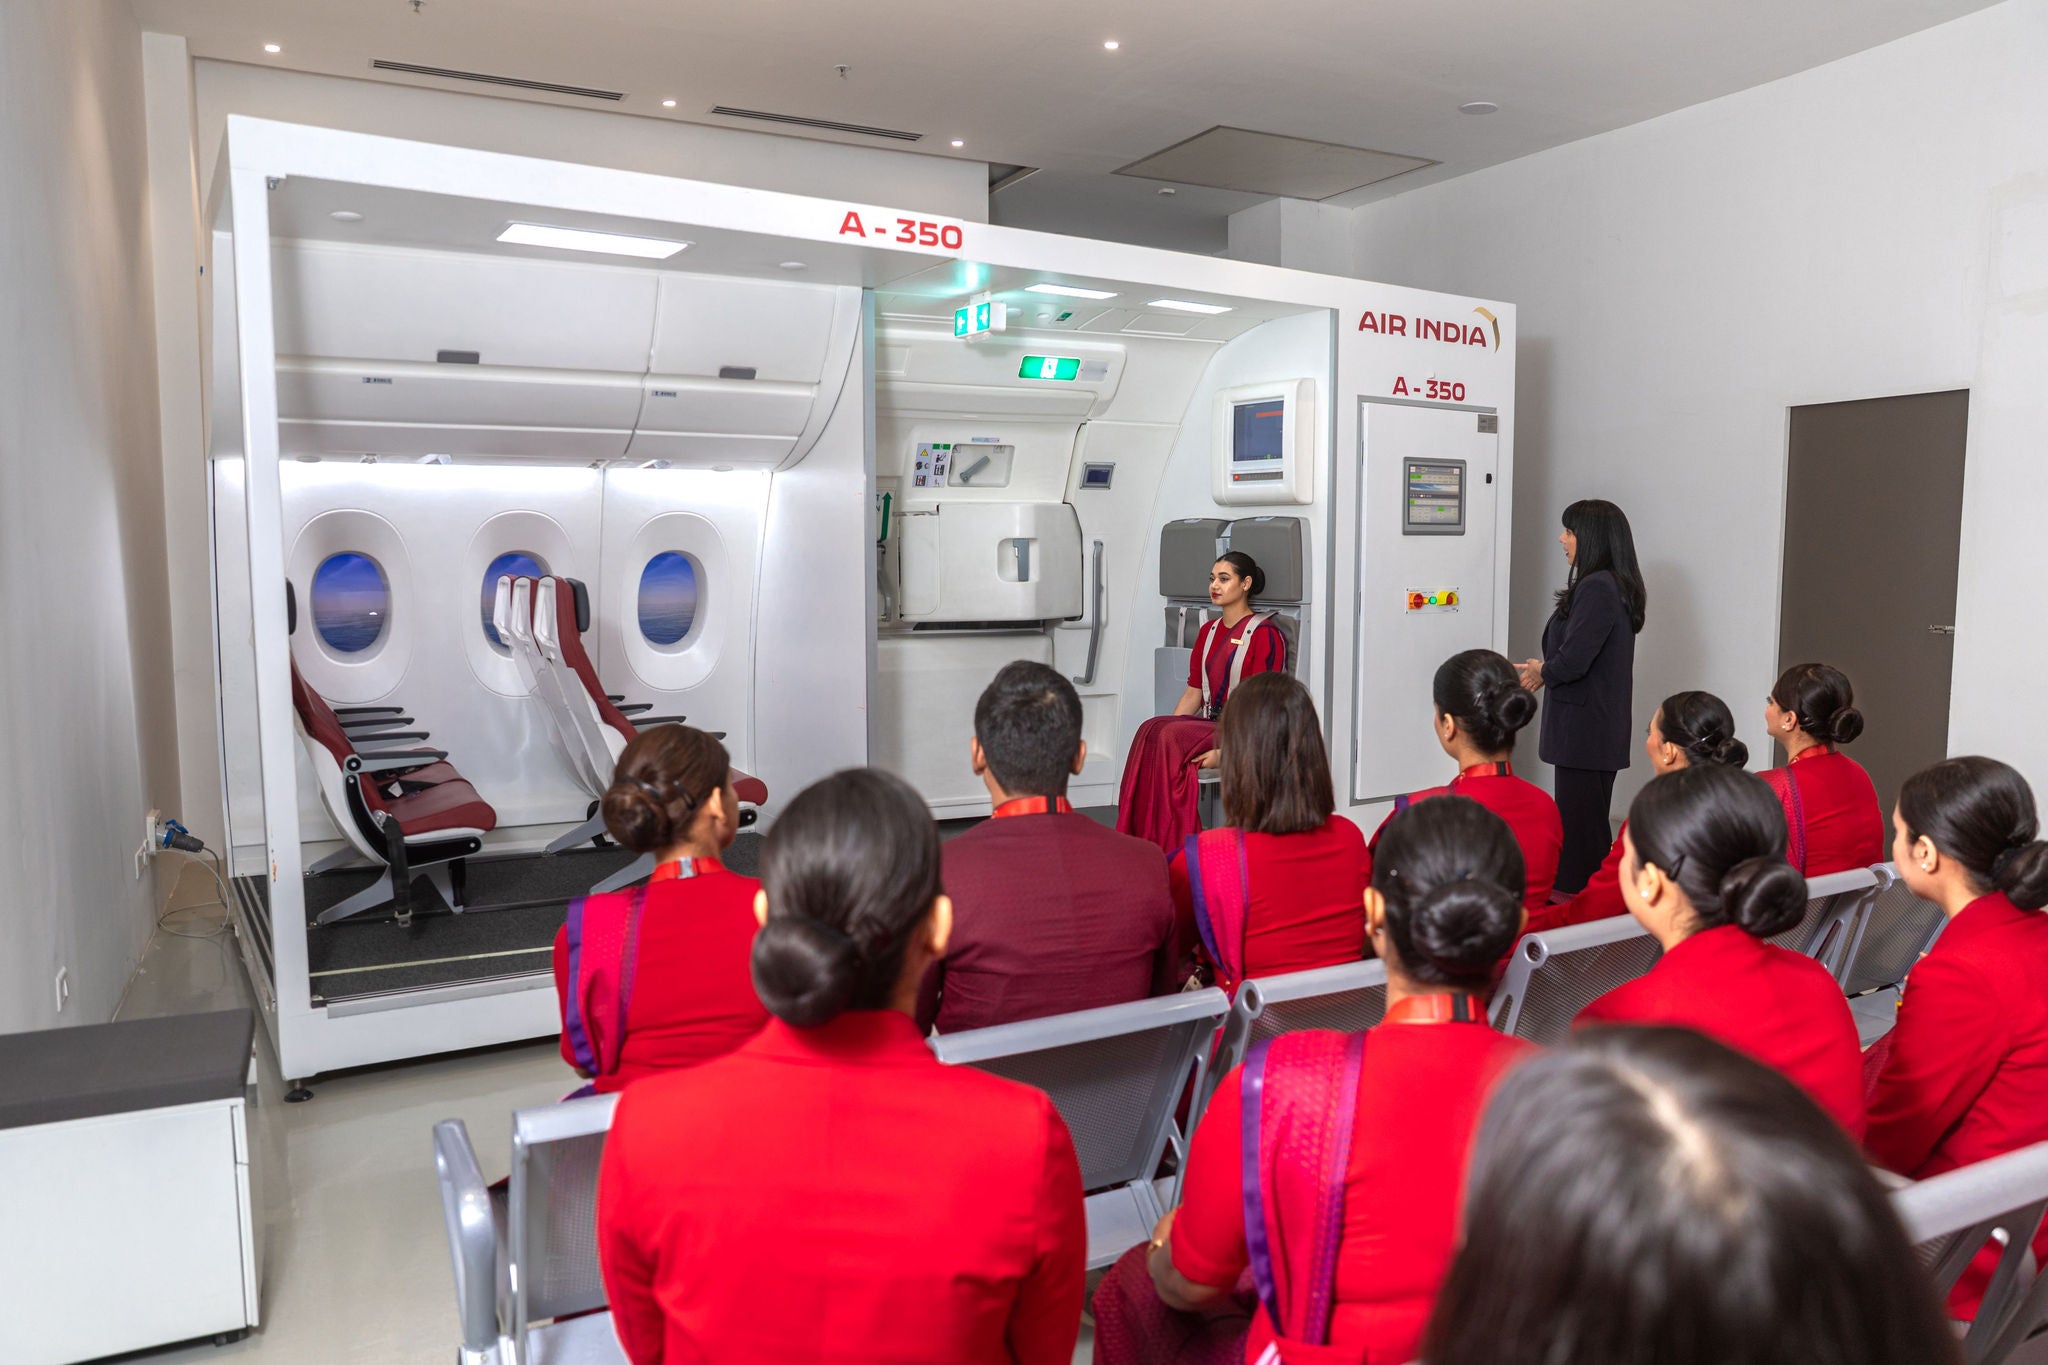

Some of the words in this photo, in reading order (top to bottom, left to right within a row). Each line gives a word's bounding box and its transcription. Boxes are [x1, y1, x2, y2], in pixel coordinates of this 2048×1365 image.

[839, 211, 866, 237] A
[896, 218, 962, 249] 350
[1358, 311, 1406, 336] AIR
[1415, 318, 1487, 347] INDIA
[1392, 376, 1408, 396] A
[1426, 379, 1465, 401] 350
